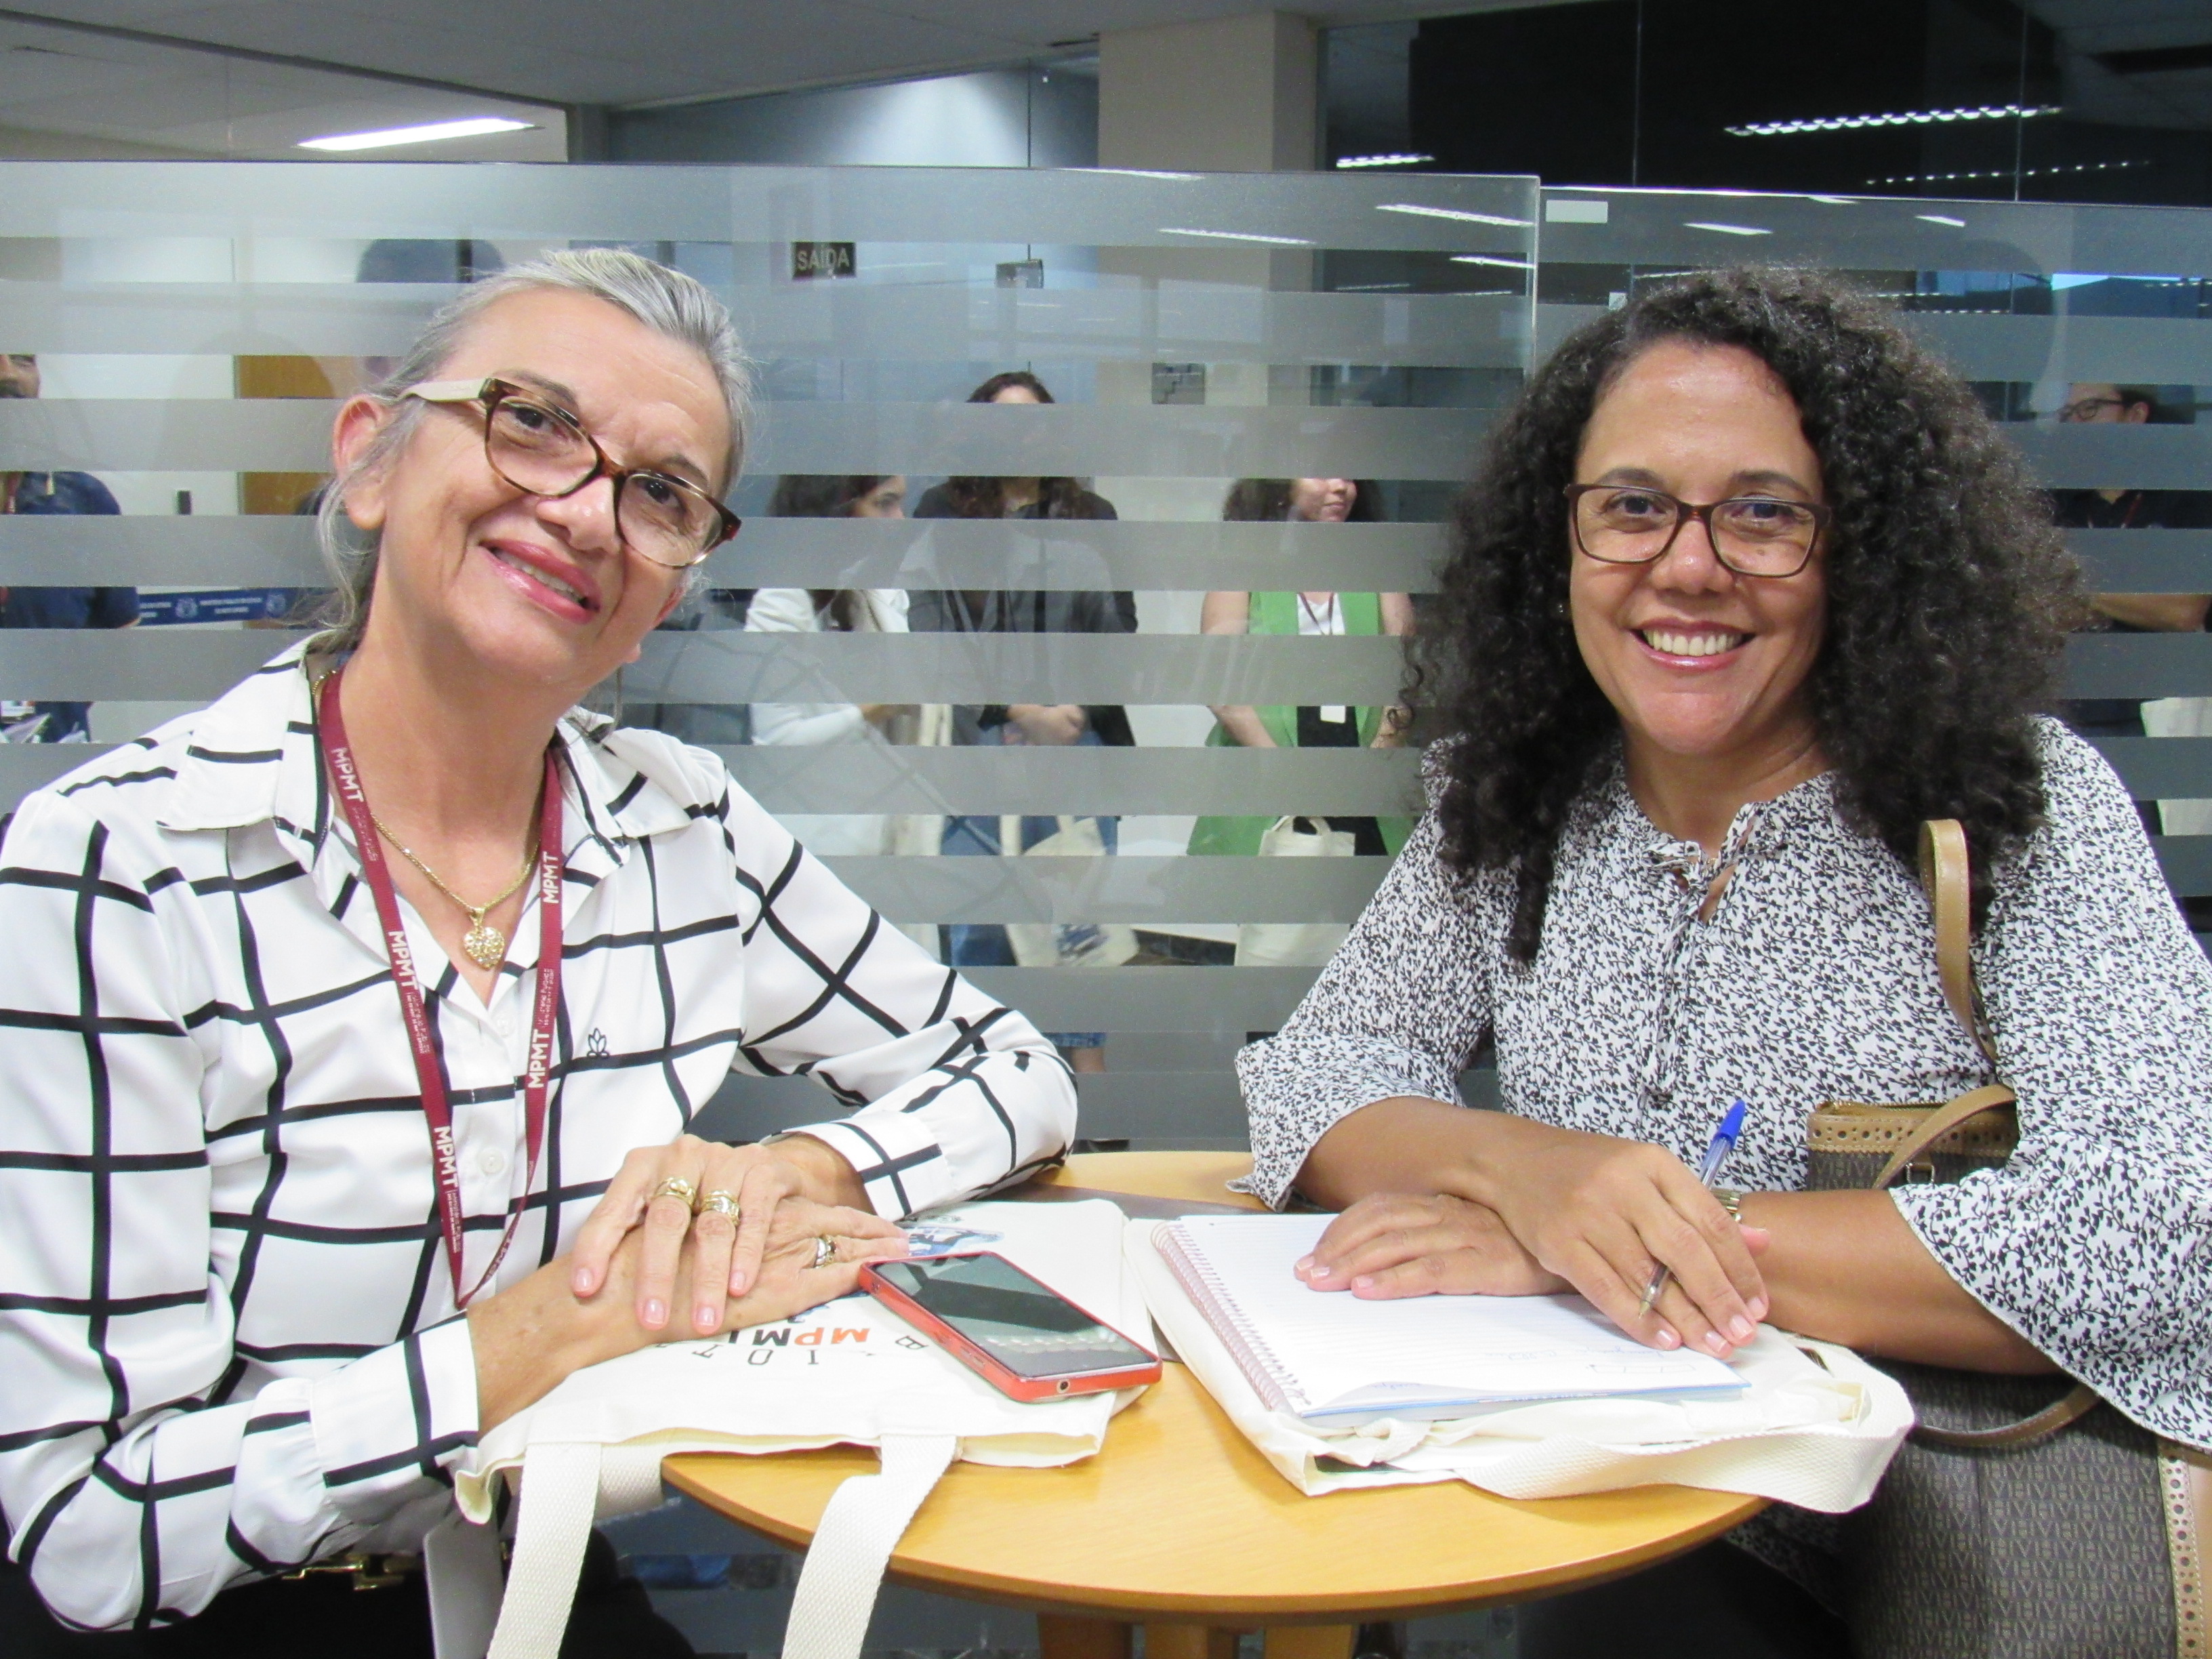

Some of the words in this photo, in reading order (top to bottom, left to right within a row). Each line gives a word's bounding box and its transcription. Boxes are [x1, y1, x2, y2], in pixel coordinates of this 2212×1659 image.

[331, 747, 365, 802] MPMT
[543, 851, 560, 904] MPMT
[388, 930, 418, 990] MPMT
[528, 1029, 550, 1088] MPMT
[434, 1126, 458, 1187] MPMT
